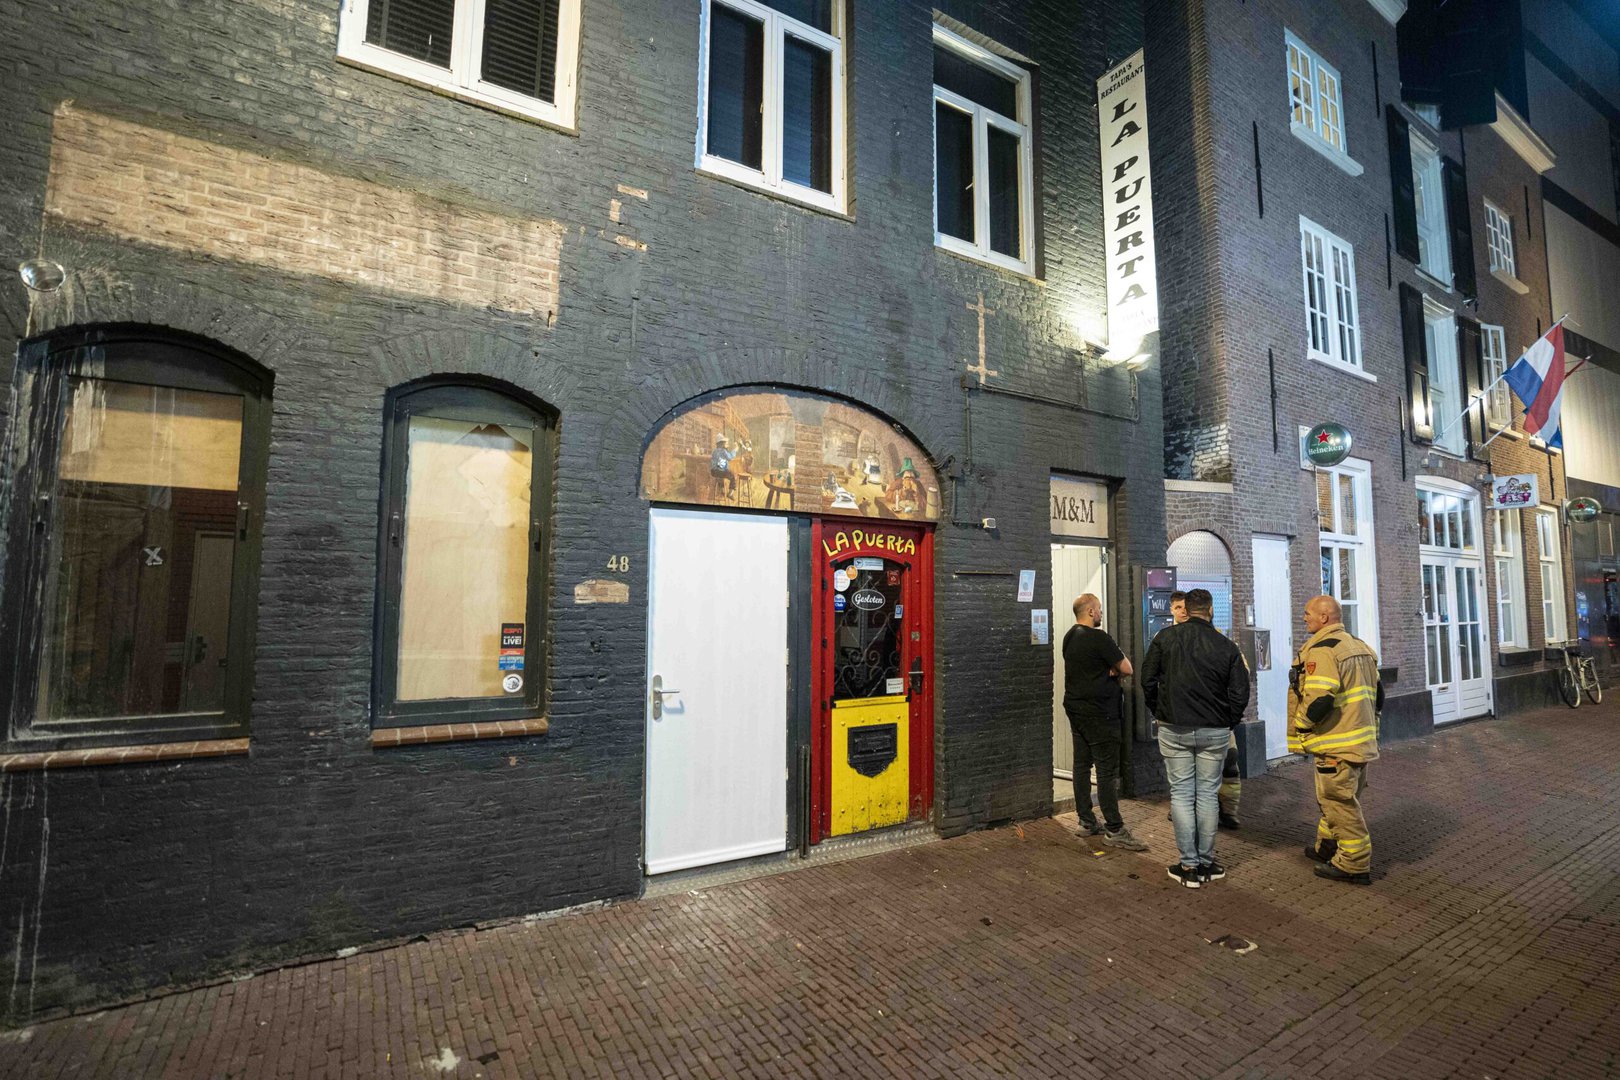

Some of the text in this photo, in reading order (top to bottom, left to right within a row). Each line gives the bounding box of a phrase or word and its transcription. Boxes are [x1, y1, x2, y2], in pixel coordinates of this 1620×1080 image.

[1100, 64, 1145, 100] RESTAURANT
[1110, 62, 1132, 83] TAPA'S
[1110, 98, 1142, 147] LA
[1112, 155, 1148, 306] PUERTA
[1308, 445, 1344, 456] Heineken
[1052, 494, 1095, 524] M&M
[822, 532, 850, 557] LA
[606, 555, 630, 573] 48
[854, 594, 883, 605] Gesloten
